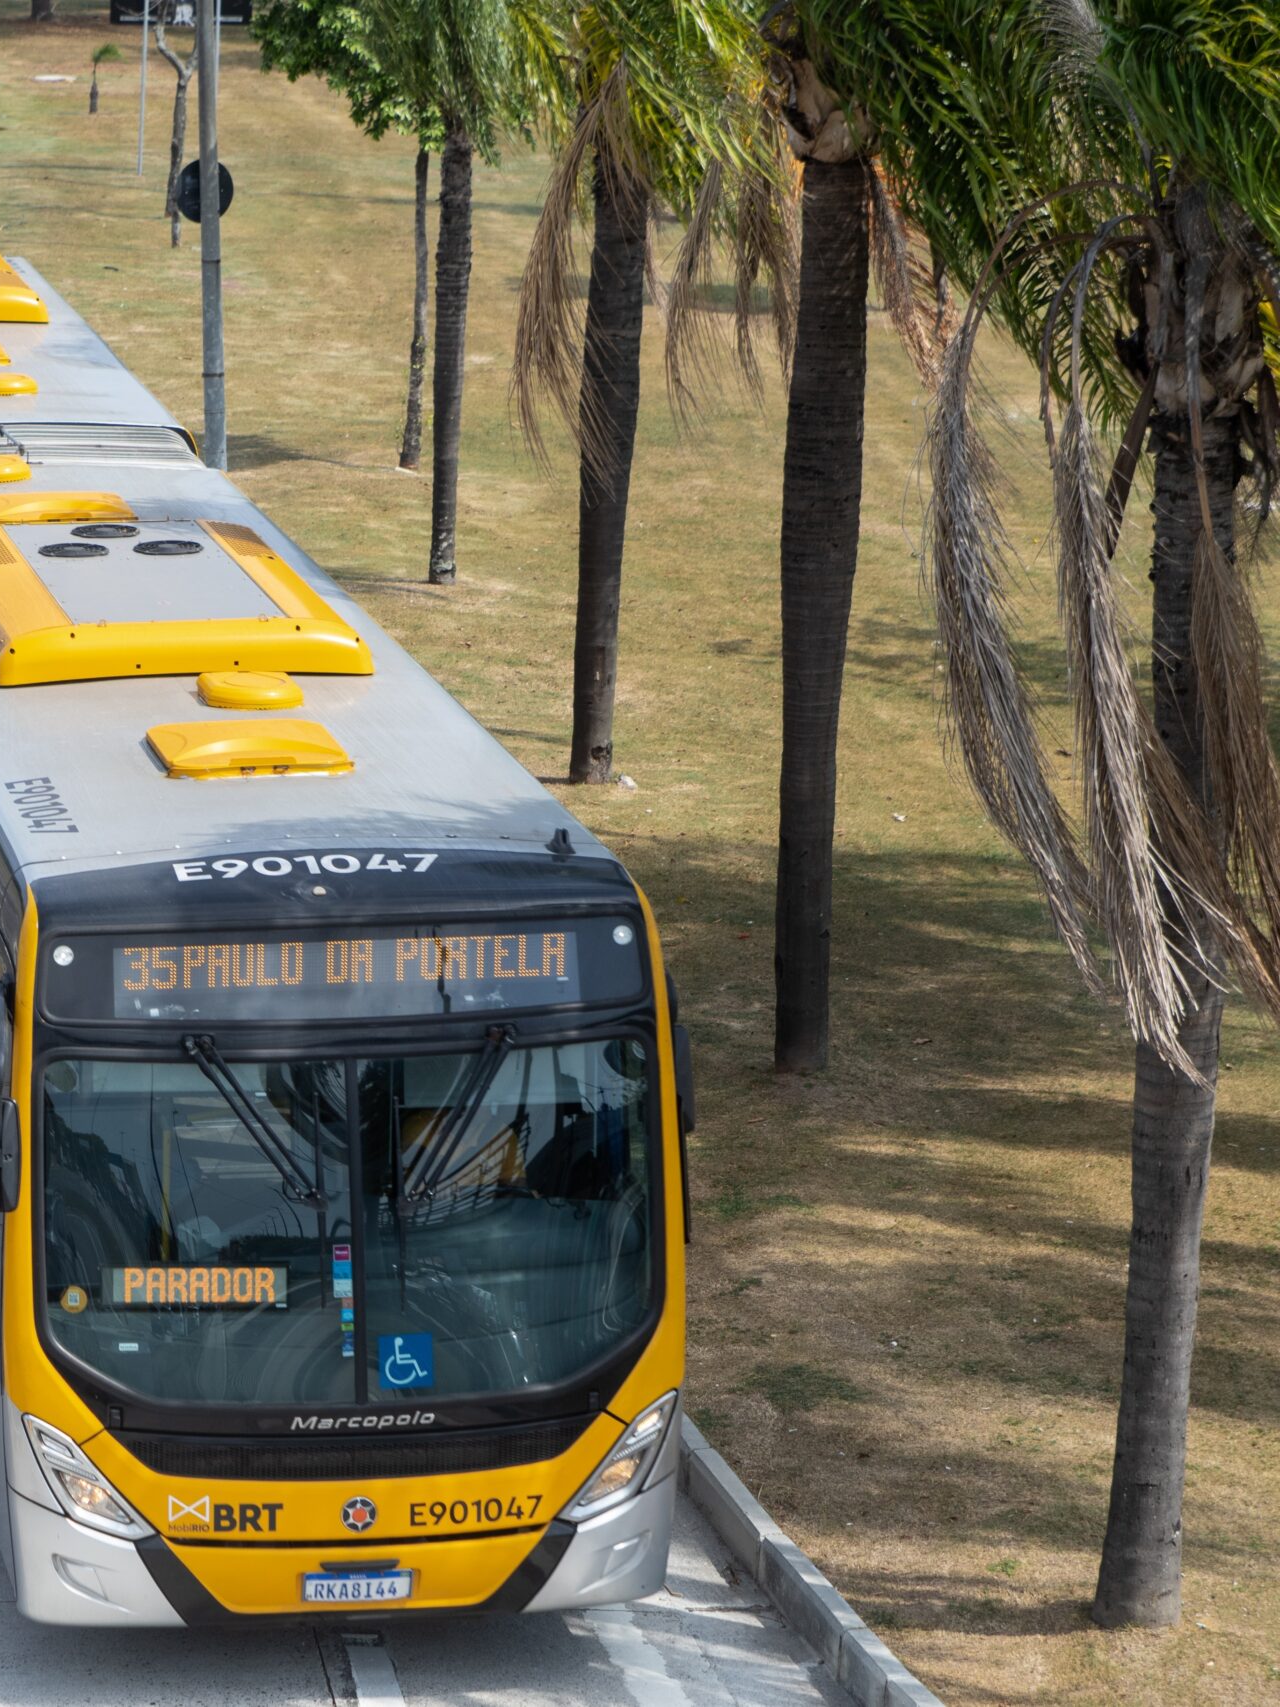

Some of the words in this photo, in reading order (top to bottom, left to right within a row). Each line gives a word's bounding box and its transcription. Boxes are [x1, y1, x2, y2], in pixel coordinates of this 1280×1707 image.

[4, 776, 80, 834] E901047
[172, 852, 439, 883] E901047
[326, 938, 374, 984] DA
[395, 931, 567, 984] PORTELA
[123, 1266, 277, 1304] PARADOR
[290, 1410, 436, 1431] Marcopolo
[213, 1503, 284, 1532] BRT
[409, 1494, 544, 1528] E901047
[313, 1581, 398, 1600] RKA8I44
